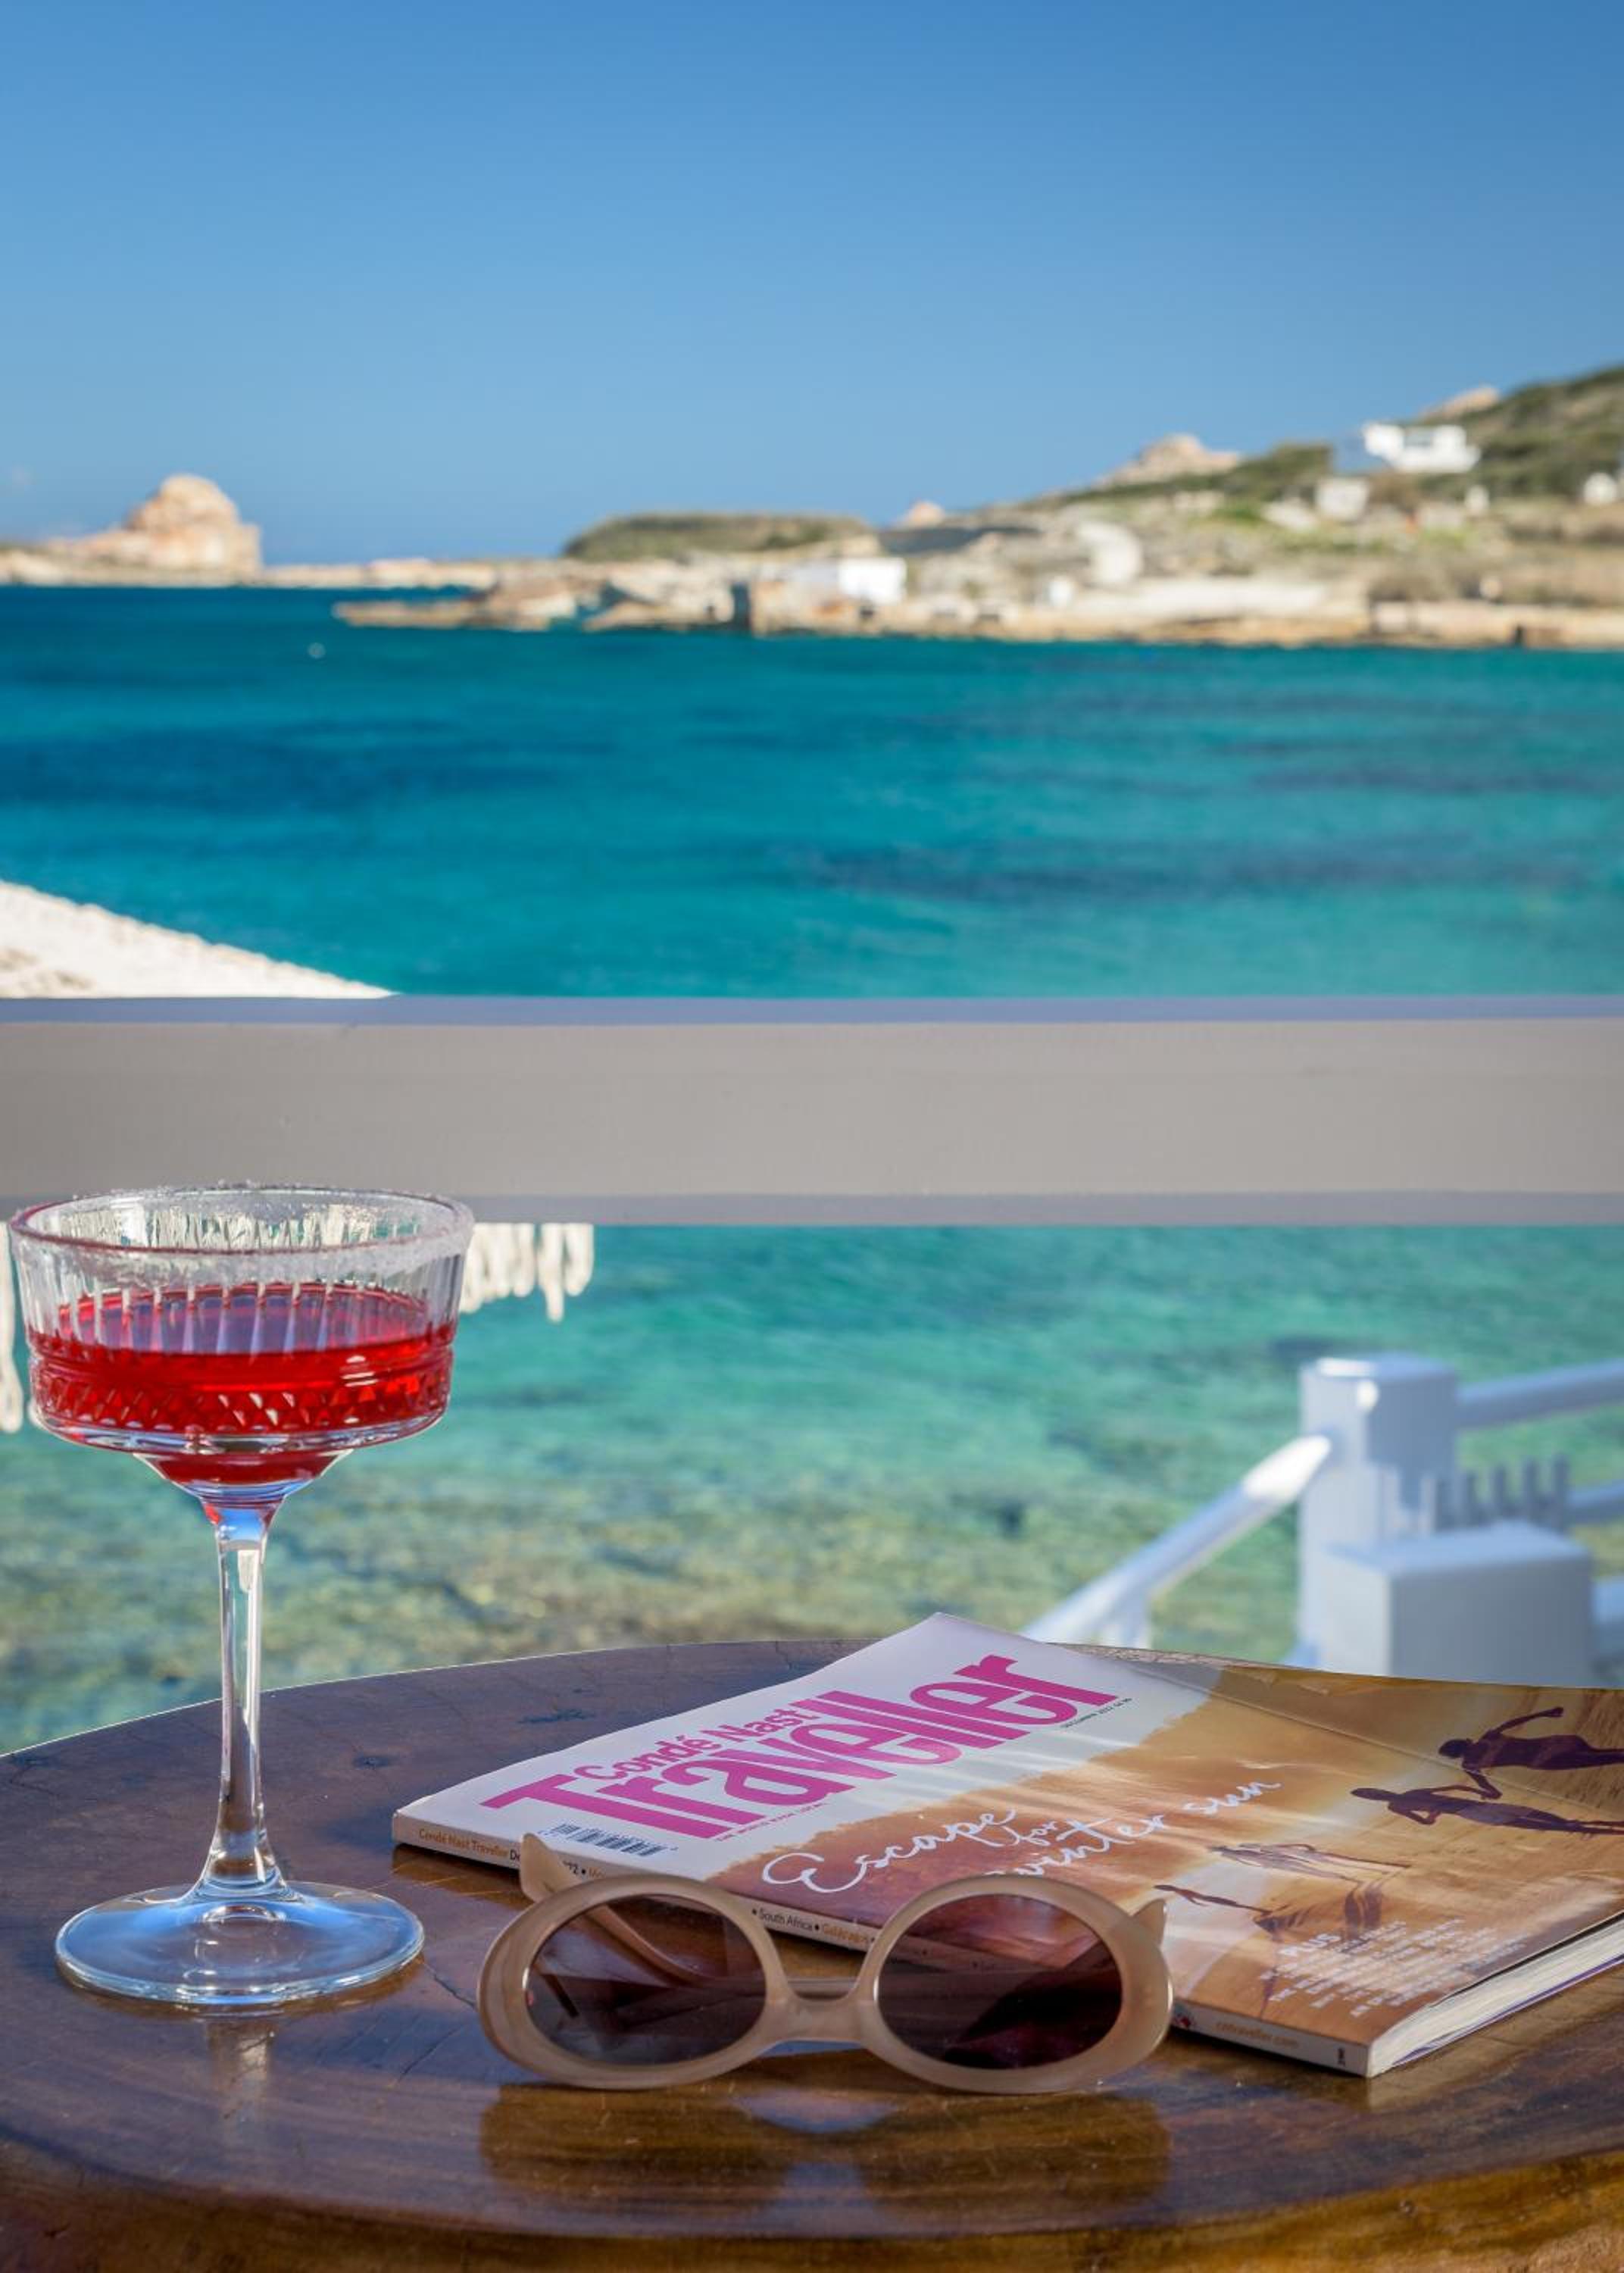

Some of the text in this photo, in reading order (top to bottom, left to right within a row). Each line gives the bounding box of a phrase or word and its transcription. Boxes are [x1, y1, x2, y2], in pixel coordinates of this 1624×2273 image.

[479, 1654, 1117, 1840] Traveller
[573, 1709, 820, 1780] Condé Nast
[1183, 1781, 1282, 1816] sun
[761, 1809, 1017, 1893] Escape
[1001, 1820, 1058, 1846] for
[787, 1915, 813, 1932] Africa
